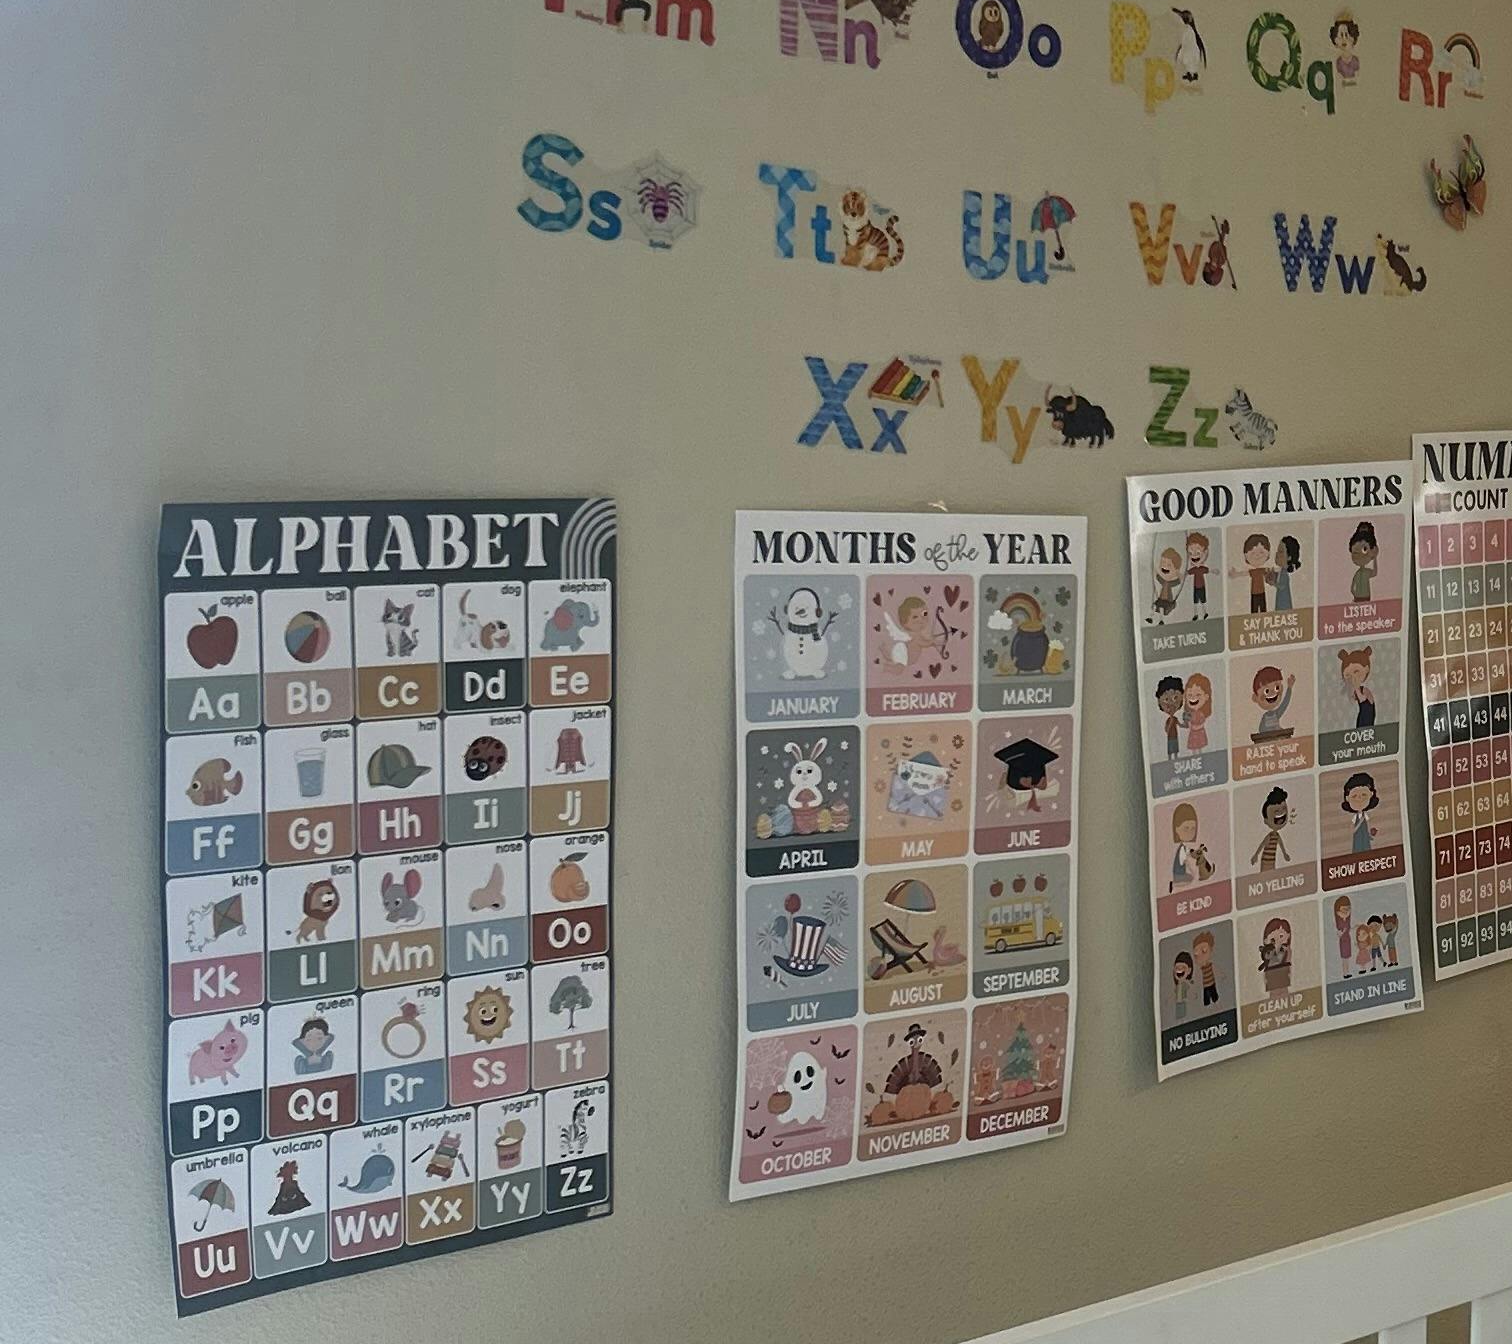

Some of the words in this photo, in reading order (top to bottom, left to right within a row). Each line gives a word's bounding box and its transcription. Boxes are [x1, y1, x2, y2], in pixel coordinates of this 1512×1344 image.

[1110, 1, 1174, 114] Pp
[1246, 12, 1336, 115] Qq
[1399, 29, 1452, 107] Rr
[517, 134, 623, 241] Ss
[759, 163, 835, 264] Tt
[963, 190, 1049, 285] Uu
[1130, 203, 1203, 286] Vv
[1273, 213, 1375, 294] Ww
[797, 356, 908, 454] Xx
[963, 355, 1041, 464] Yy
[1145, 366, 1219, 448] Zz
[1139, 485, 1233, 524] GOOD
[1243, 474, 1403, 516] MANNERS
[1453, 488, 1508, 511] COUNT
[174, 513, 560, 578] ALPHABET
[752, 530, 916, 564] MONTHS
[924, 537, 949, 571] of
[946, 533, 978, 563] the
[983, 533, 1072, 565] YEAR
[326, 590, 347, 602] ball
[416, 587, 435, 598] cat
[501, 584, 522, 598] dog
[560, 582, 608, 595] elephant
[220, 594, 254, 608] apple
[1243, 618, 1261, 631] SAY
[1264, 614, 1298, 628] PLEASE
[1344, 605, 1377, 619] LISTEN
[1338, 620, 1353, 632] the
[1356, 616, 1396, 633] speaker
[1153, 636, 1176, 651] TAKE
[1179, 632, 1207, 648] TURNS
[1249, 630, 1281, 644] THANK
[1284, 628, 1303, 640] YOU
[377, 674, 419, 708] Cc
[463, 669, 506, 702] Dd
[550, 665, 590, 696] Ee
[188, 687, 241, 720] Aa
[286, 680, 332, 715] Bb
[767, 696, 839, 716] JANUARY
[882, 692, 957, 711] FEBRUARY
[1003, 688, 1052, 706] MARCH
[490, 714, 522, 726] insect
[571, 707, 608, 723] jacket
[320, 727, 351, 742] glass
[418, 720, 437, 732] hat
[1344, 729, 1375, 744] COVER
[234, 733, 257, 747] fish
[1247, 745, 1275, 761] RAISE
[1277, 741, 1300, 756] your
[1332, 746, 1354, 762] your
[1356, 741, 1386, 756] mouth
[1278, 756, 1307, 771] speak
[472, 798, 498, 830] Ii
[558, 789, 582, 825] Jj
[378, 807, 422, 842] Hh
[192, 823, 235, 862] Ff
[288, 817, 335, 855] Gg
[565, 832, 605, 846] orange
[1007, 830, 1040, 848] JUNE
[401, 851, 439, 864] mouse
[496, 841, 522, 854] nose
[902, 839, 934, 857] MAY
[330, 862, 352, 876] lion
[780, 849, 827, 870] APRIL
[1328, 865, 1356, 880] SHOW
[1358, 856, 1397, 873] RESPECT
[231, 873, 259, 887] kite
[1248, 883, 1264, 897] NO
[1265, 874, 1305, 892] YELLING
[1189, 896, 1213, 911] KIND
[548, 917, 592, 950] Oo
[465, 928, 509, 961] Nn
[300, 952, 327, 986] Ll
[371, 942, 434, 976] Mm
[580, 960, 606, 972] tree
[192, 968, 241, 1001] Kk
[505, 970, 525, 982] sun
[983, 966, 1060, 993] SEPTEMBER
[417, 984, 441, 999] ring
[889, 984, 943, 1006] AUGUST
[1334, 988, 1365, 1005] STAND
[1367, 984, 1382, 998] IN
[1383, 978, 1407, 995] LINE
[315, 997, 355, 1013] queen
[787, 1002, 820, 1022] JULY
[1258, 998, 1288, 1015] CLEAN
[1290, 994, 1303, 1008] UP
[240, 1010, 260, 1027] pig
[1247, 1016, 1273, 1033] after
[1274, 1005, 1317, 1029] yourself
[1169, 1038, 1183, 1052] NO
[1185, 1023, 1228, 1047] BULLYING
[555, 1042, 586, 1073] Tt
[472, 1057, 508, 1089] Ss
[384, 1073, 424, 1107] Rr
[572, 1084, 606, 1099] zebra
[288, 1087, 340, 1125] Qq
[500, 1097, 539, 1115] yogurt
[192, 1104, 241, 1143] Pp
[411, 1111, 472, 1132] xylophone
[980, 1105, 1049, 1133] DECEMBER
[362, 1123, 399, 1139] whale
[869, 1125, 950, 1154] NOVEMBER
[272, 1138, 323, 1157] volcano
[186, 1152, 244, 1172] umbrella
[761, 1148, 832, 1175] OCTOBER
[559, 1167, 594, 1199] Zz
[489, 1179, 531, 1215] Yy
[418, 1196, 462, 1229] Xx
[336, 1211, 398, 1247] Ww
[264, 1225, 315, 1260] Vv
[192, 1244, 236, 1279] Uu
